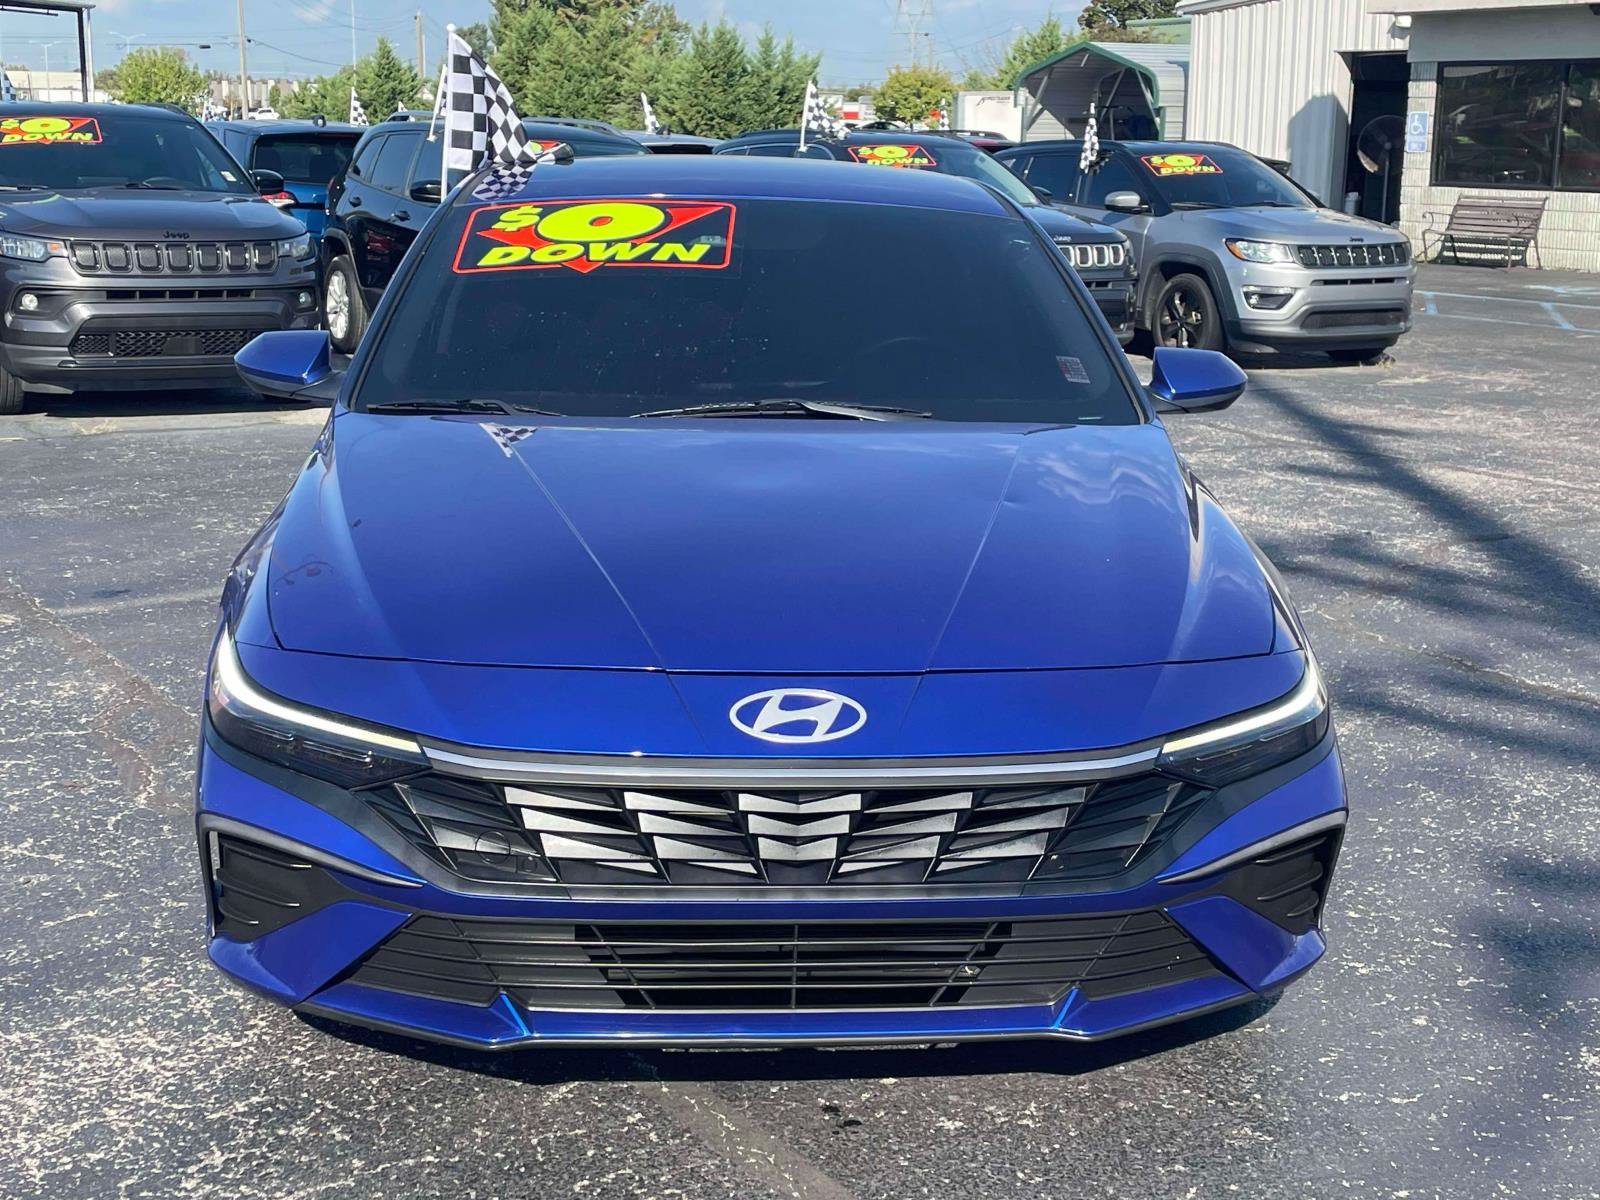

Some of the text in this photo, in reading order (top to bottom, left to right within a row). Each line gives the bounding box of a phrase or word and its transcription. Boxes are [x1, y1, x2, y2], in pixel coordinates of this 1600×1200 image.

[2, 132, 93, 142] DOWN
[1160, 165, 1215, 174] DOWN
[162, 230, 190, 240] Jeep
[477, 243, 711, 266] DOWN
